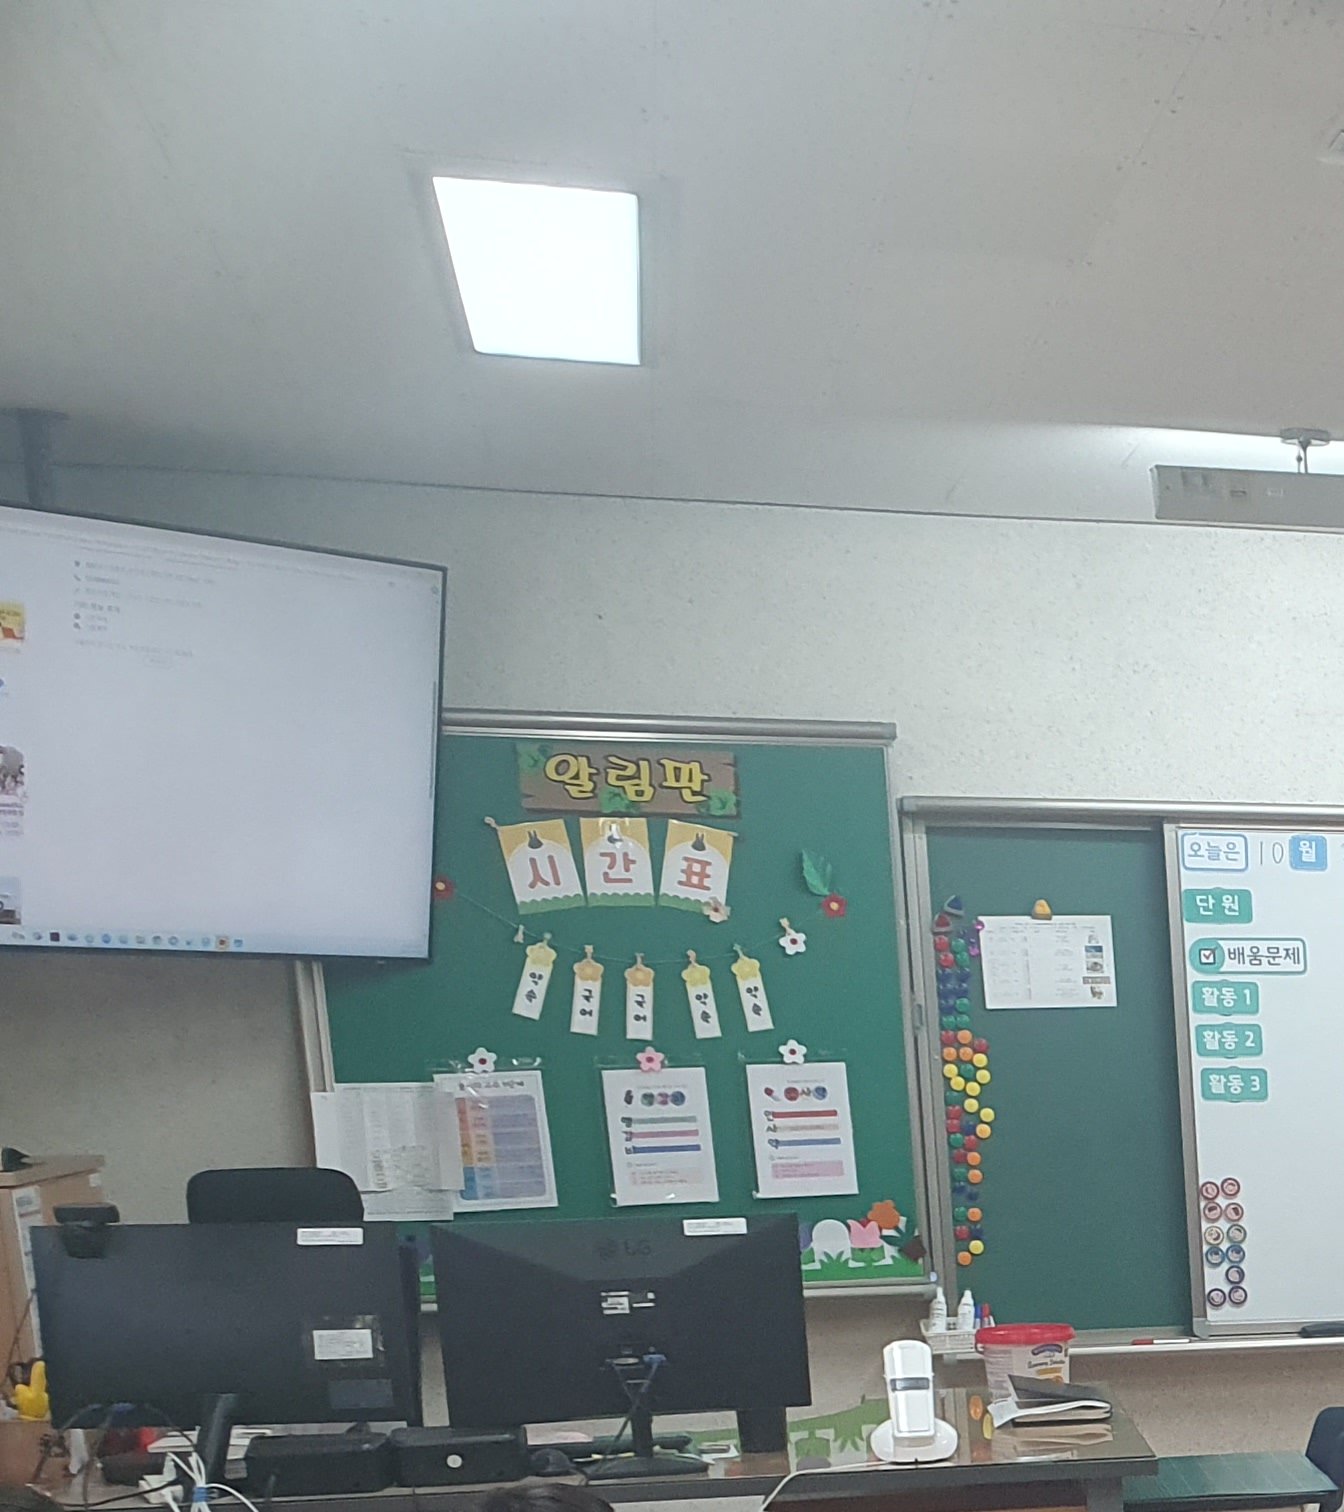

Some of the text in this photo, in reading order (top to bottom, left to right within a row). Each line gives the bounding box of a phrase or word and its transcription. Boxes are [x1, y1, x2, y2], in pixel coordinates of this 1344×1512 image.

[545, 752, 712, 804] 알림판
[1187, 840, 1242, 862] 오늘은
[1259, 841, 1285, 866] 10
[1299, 840, 1317, 863] 월
[1226, 943, 1302, 967] 배움문제
[1201, 986, 1253, 1008] 활동 1
[1202, 1029, 1256, 1051] 활동 2
[1207, 1073, 1261, 1095] 활동 3
